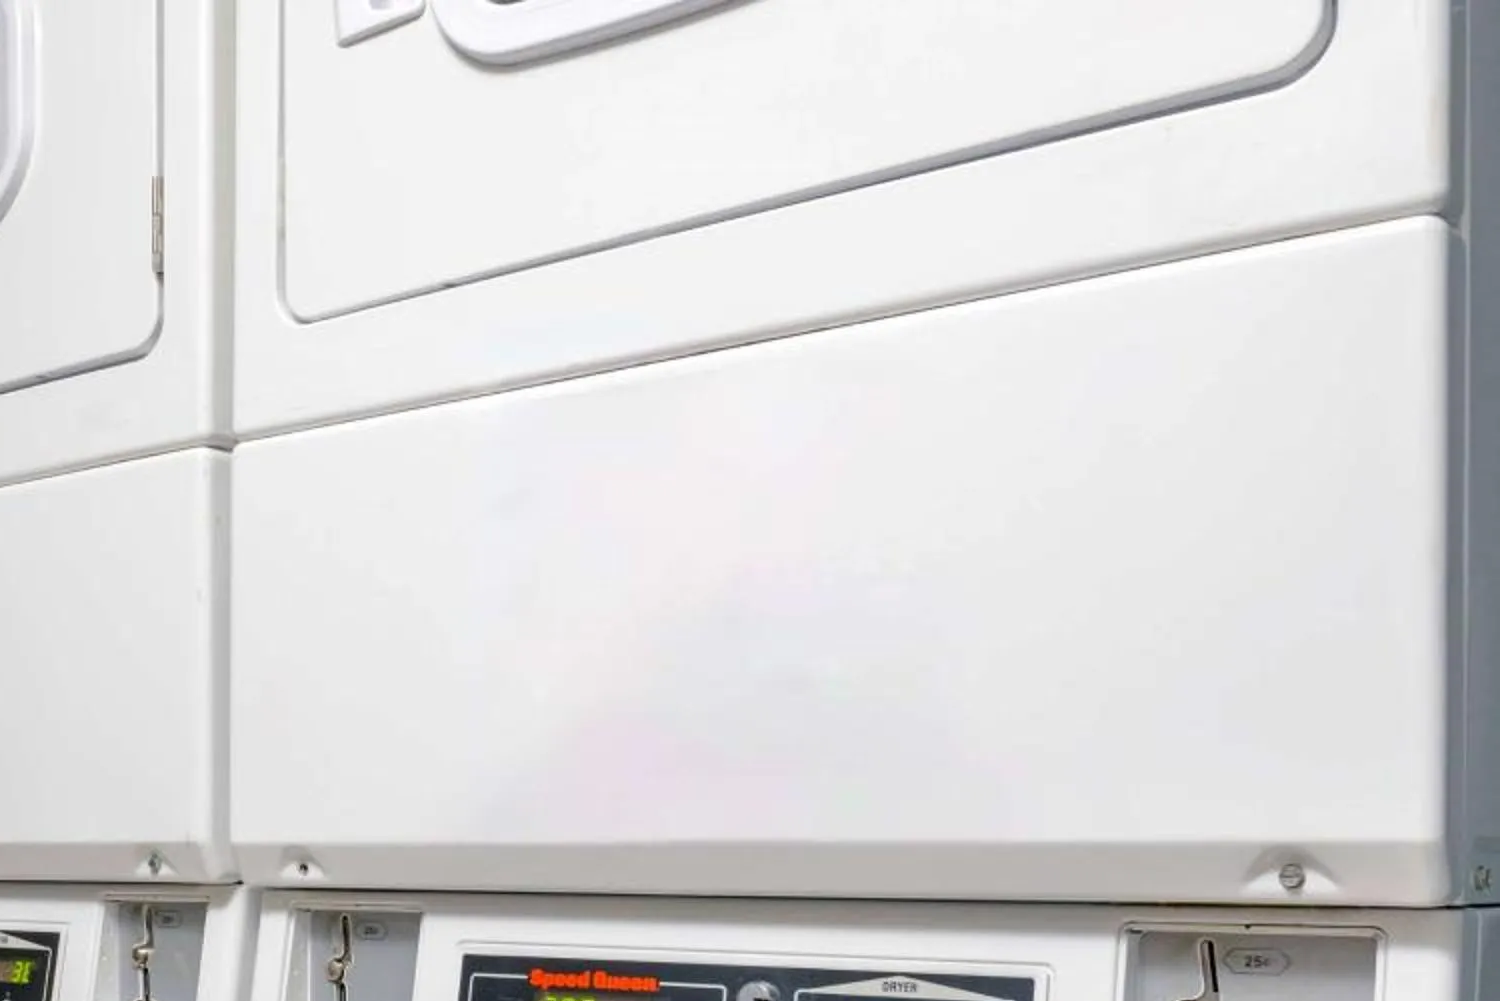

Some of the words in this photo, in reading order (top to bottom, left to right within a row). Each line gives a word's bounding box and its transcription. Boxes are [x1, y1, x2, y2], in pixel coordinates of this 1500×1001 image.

[529, 968, 591, 990] Speed
[593, 970, 660, 992] Queen
[882, 981, 918, 993] DRYER
